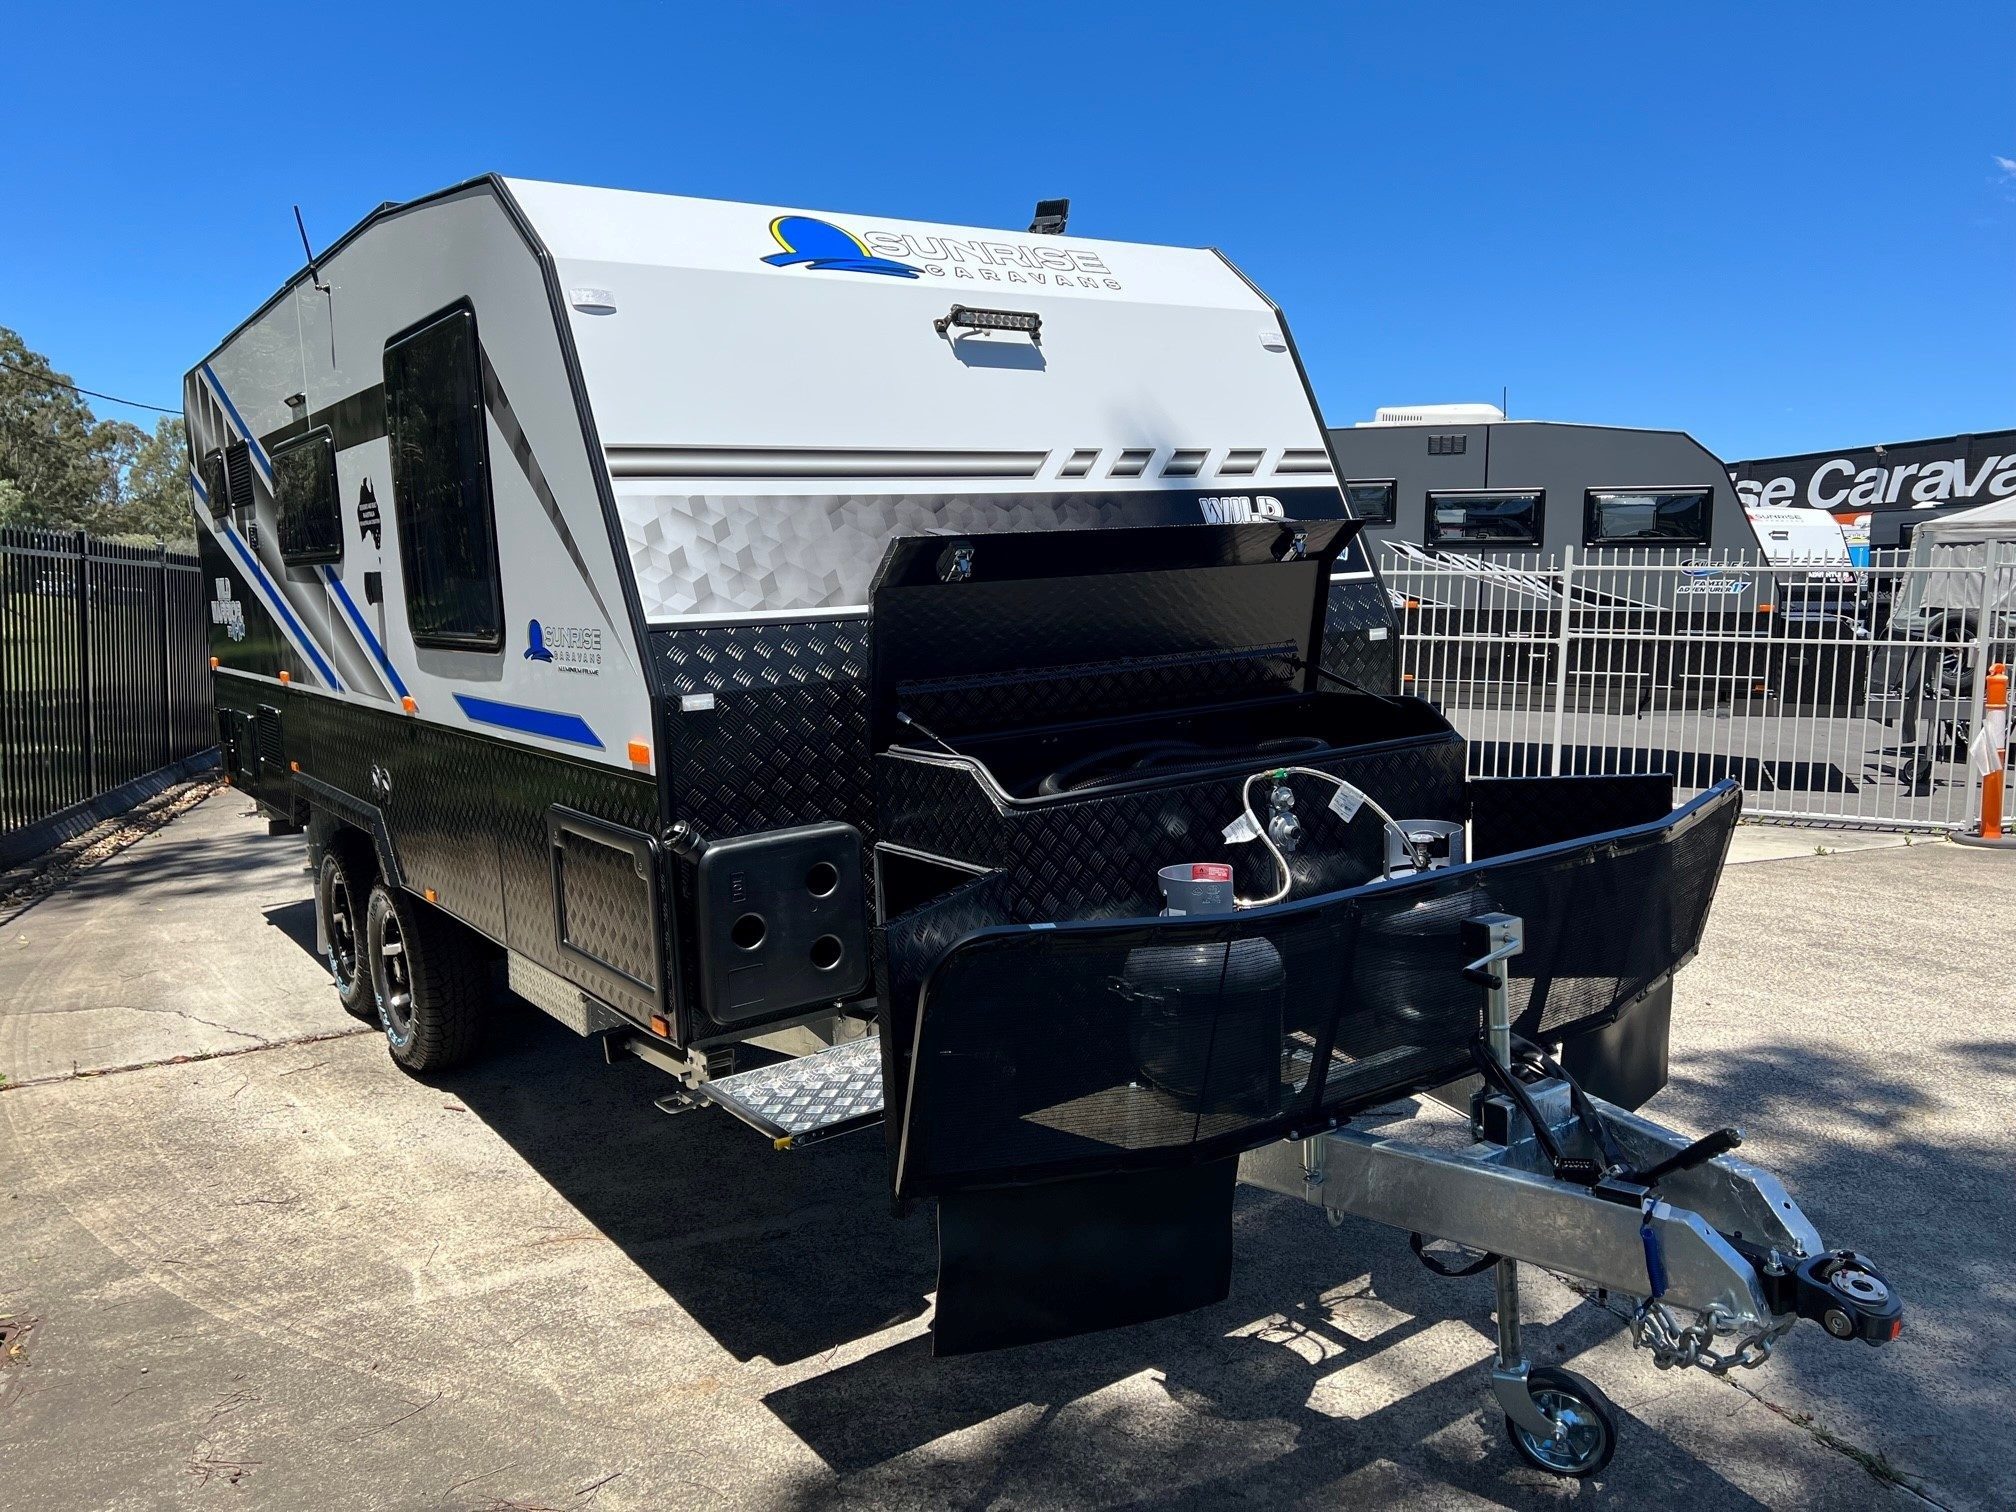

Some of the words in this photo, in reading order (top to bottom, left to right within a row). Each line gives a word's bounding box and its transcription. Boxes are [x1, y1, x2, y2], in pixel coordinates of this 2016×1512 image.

[864, 231, 1111, 275] SUNRISE
[925, 264, 1124, 291] CARAVANS
[1198, 496, 1284, 524] WILD
[544, 626, 602, 651] SUNRISE
[553, 650, 602, 665] CARAVANS
